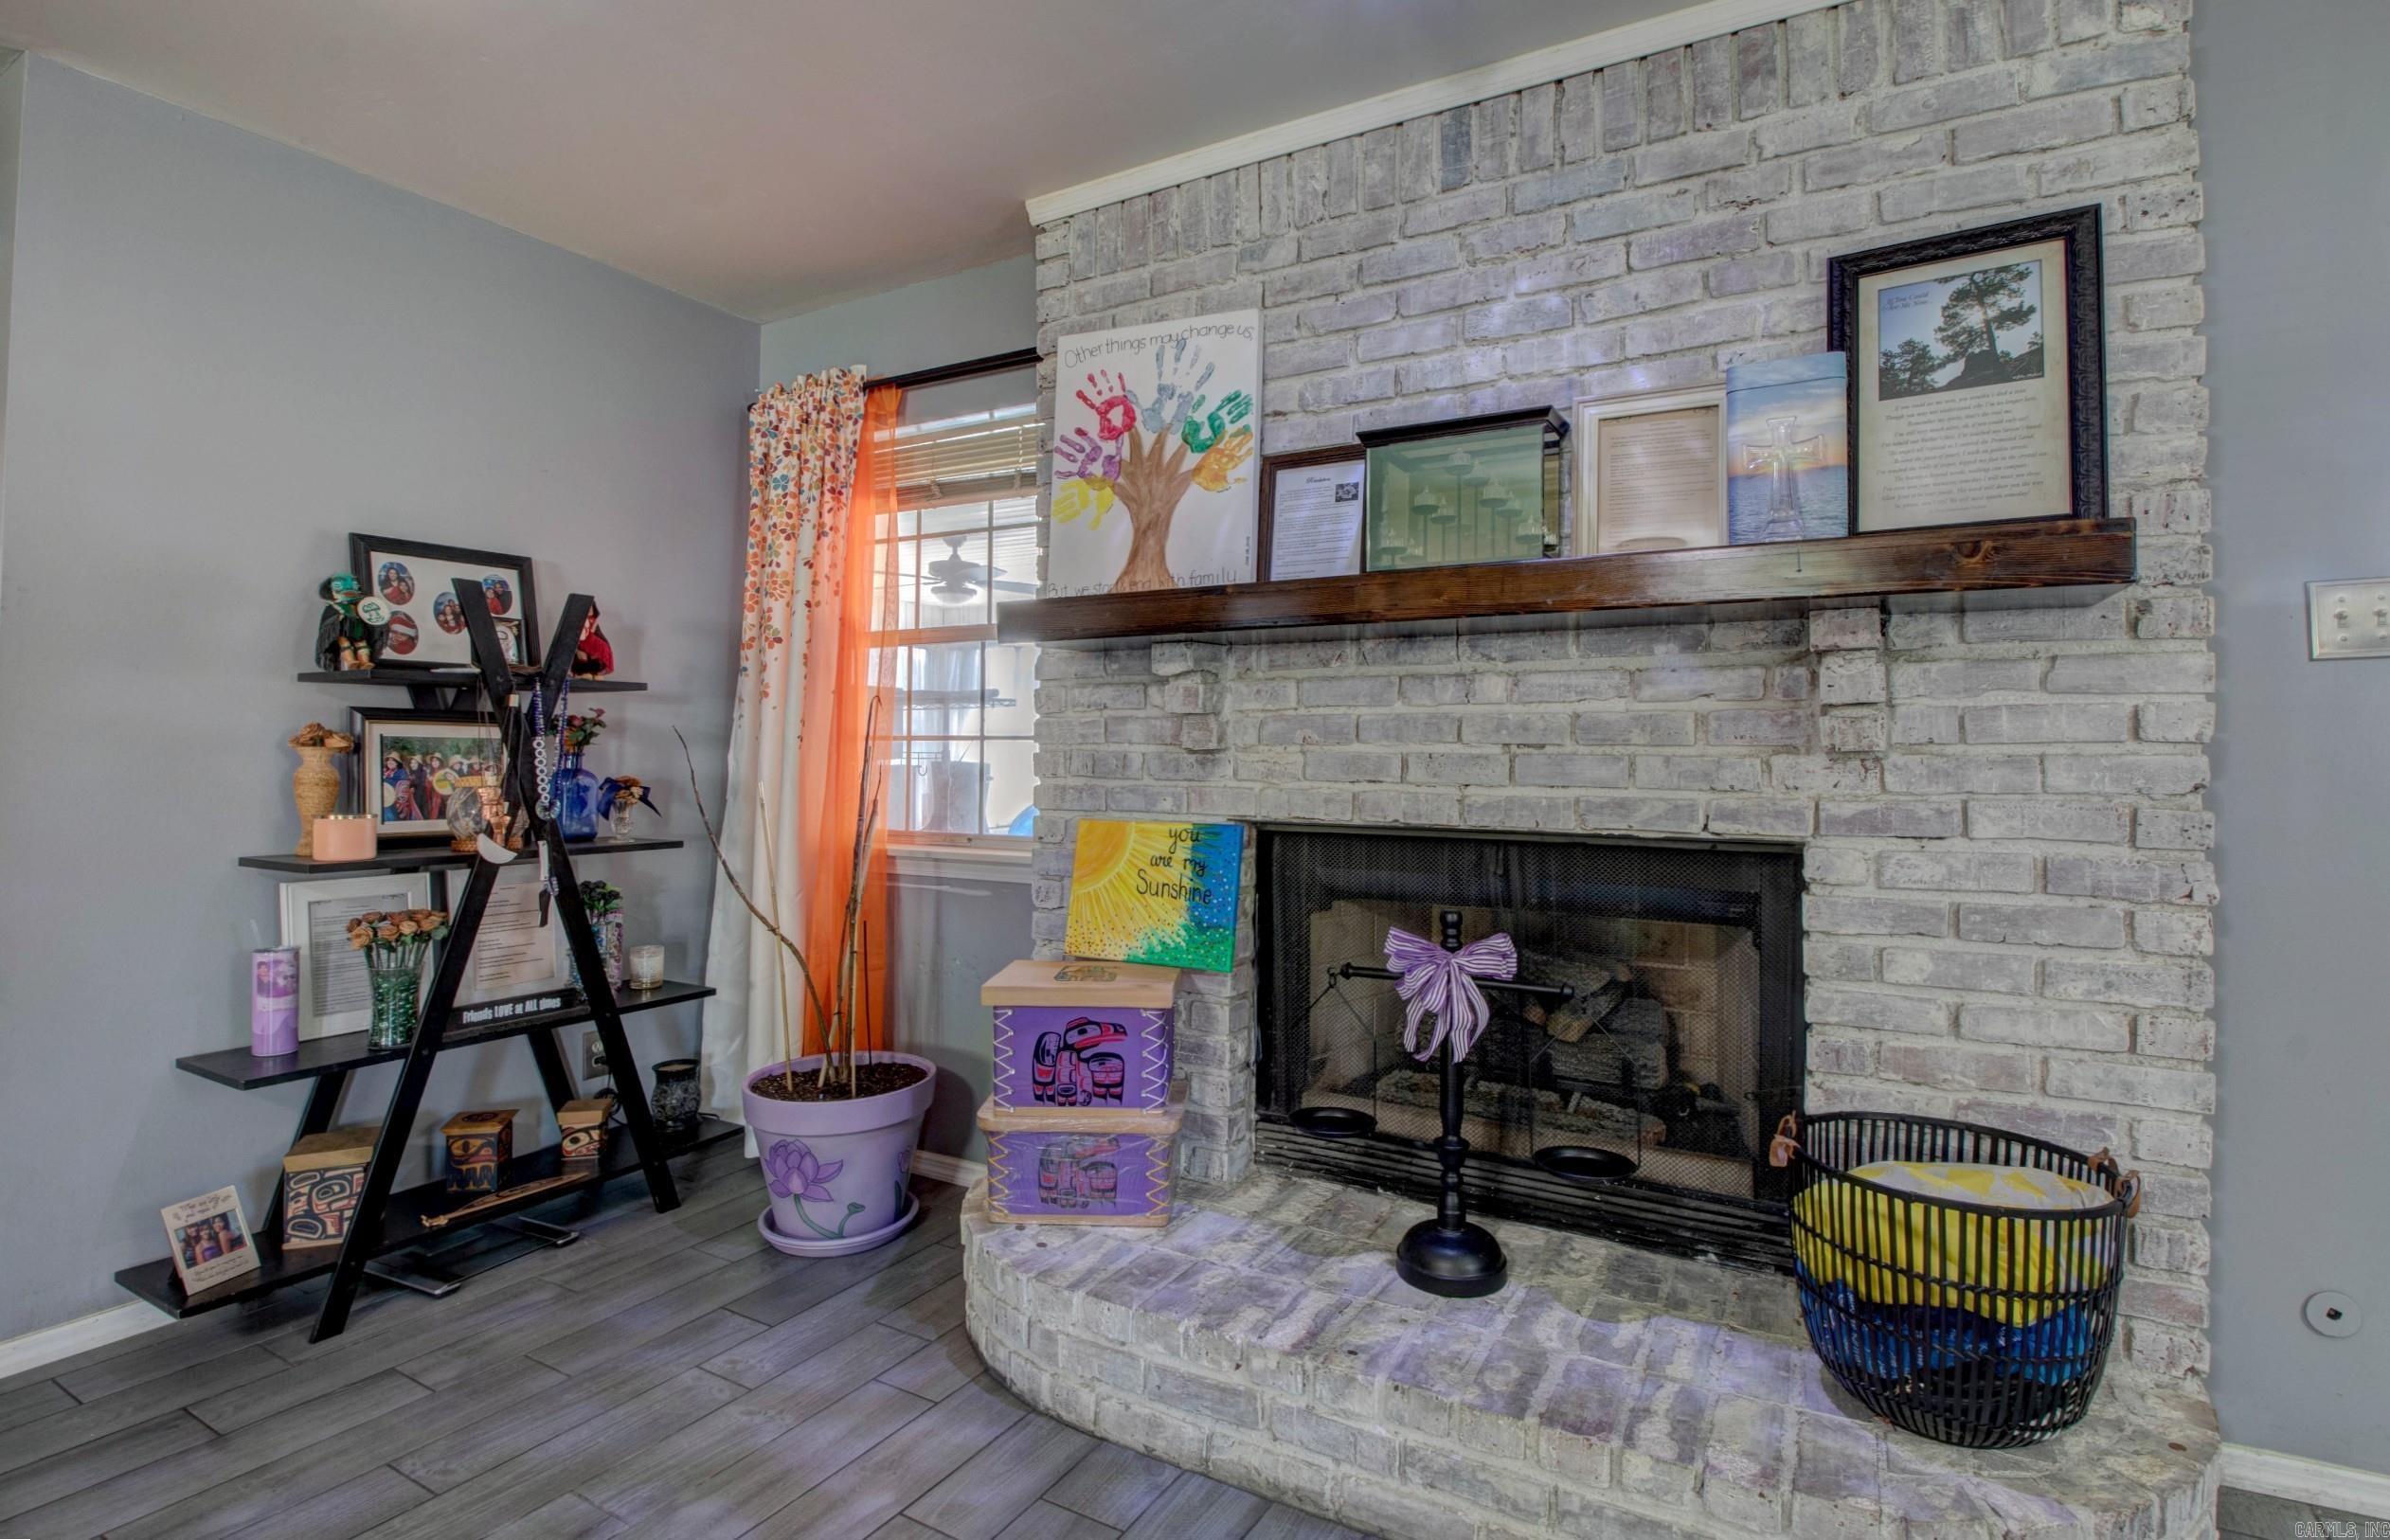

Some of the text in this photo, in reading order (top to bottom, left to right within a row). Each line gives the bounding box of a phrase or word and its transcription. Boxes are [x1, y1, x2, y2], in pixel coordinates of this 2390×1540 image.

[1065, 344, 1103, 368] Other
[1105, 337, 1146, 355] things
[1150, 332, 1180, 349] may
[1181, 323, 1234, 341] change
[1189, 566, 1237, 586] family
[1168, 828, 1201, 854] you
[1150, 855, 1209, 877] are my
[1137, 868, 1213, 904] Sunshine
[462, 1007, 493, 1024] Friends
[494, 1003, 513, 1018] LOVE
[525, 998, 538, 1012] ALL
